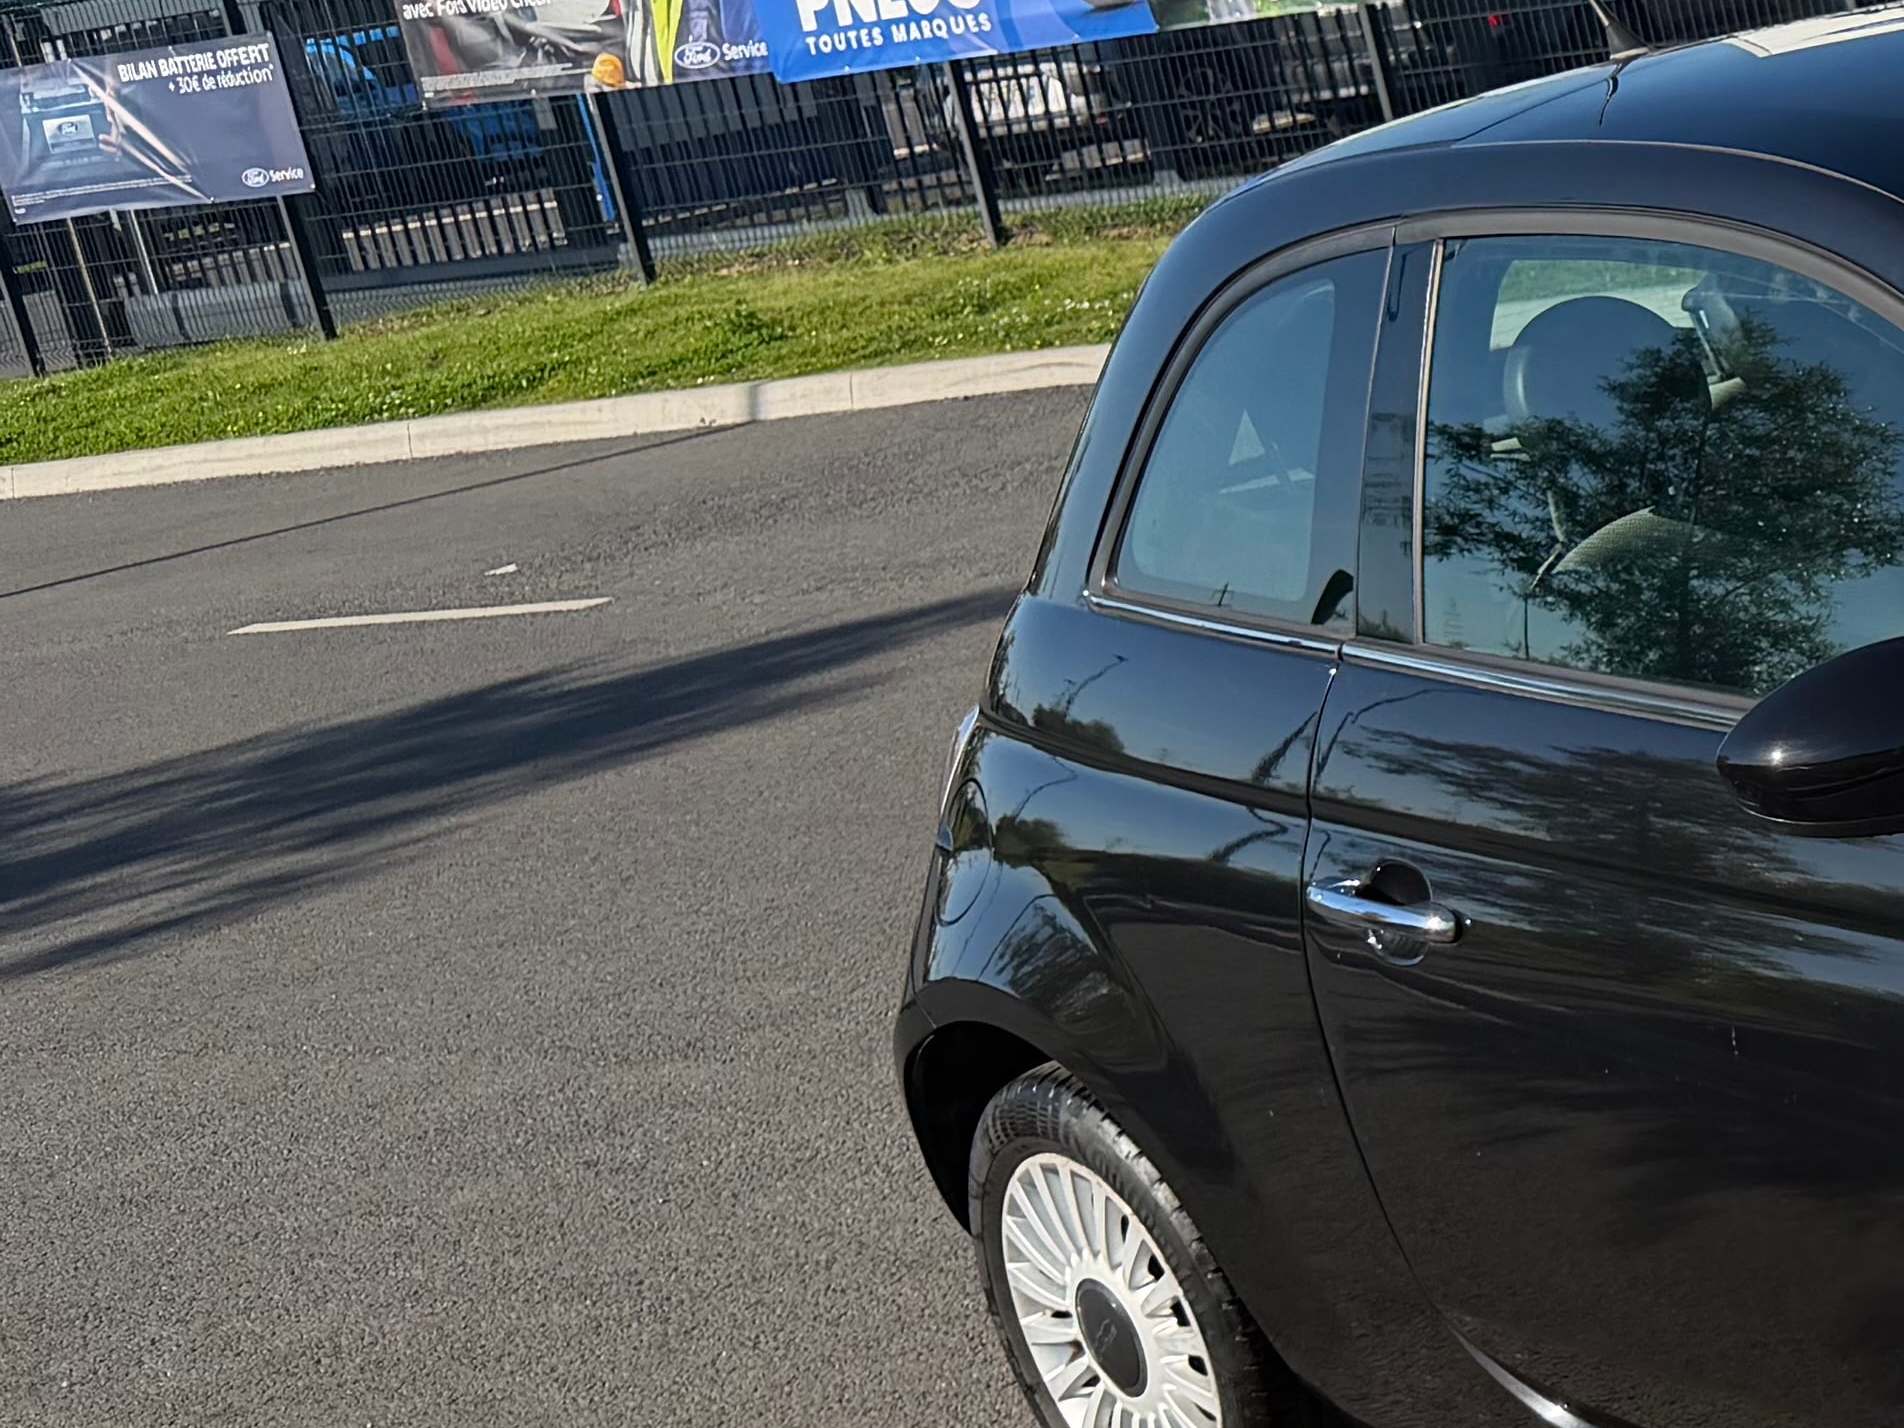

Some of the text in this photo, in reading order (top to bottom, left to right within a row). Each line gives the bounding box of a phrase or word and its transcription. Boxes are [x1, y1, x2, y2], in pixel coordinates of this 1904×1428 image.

[804, 12, 993, 56] TOUTES MARQUES
[722, 40, 769, 61] Service
[117, 42, 269, 82] BILAN BATTERIE OFFERT
[178, 74, 200, 94] 30€
[202, 73, 216, 91] de
[268, 166, 304, 183] Service
